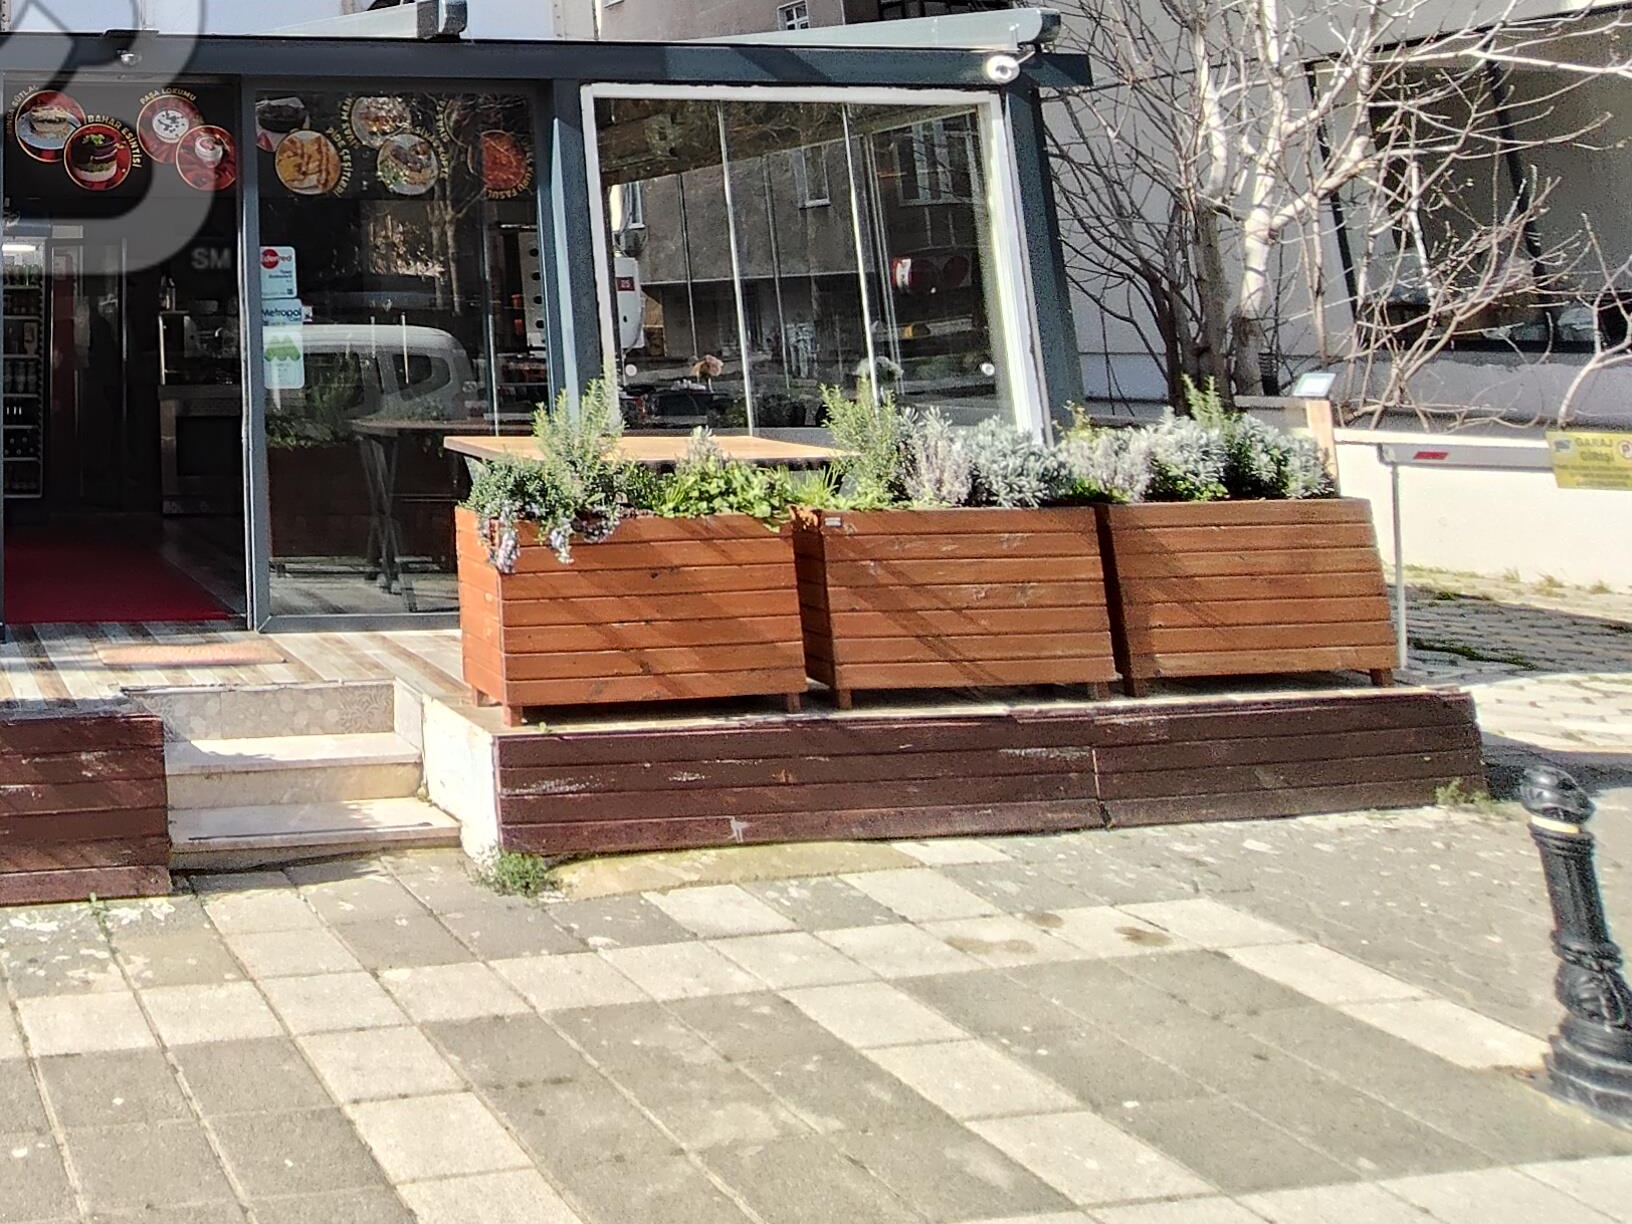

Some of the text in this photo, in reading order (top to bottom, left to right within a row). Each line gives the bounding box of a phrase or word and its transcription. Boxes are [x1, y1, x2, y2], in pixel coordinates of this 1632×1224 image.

[88, 114, 142, 168] BAHAR ESİNTİSİ
[326, 126, 346, 148] PİDE
